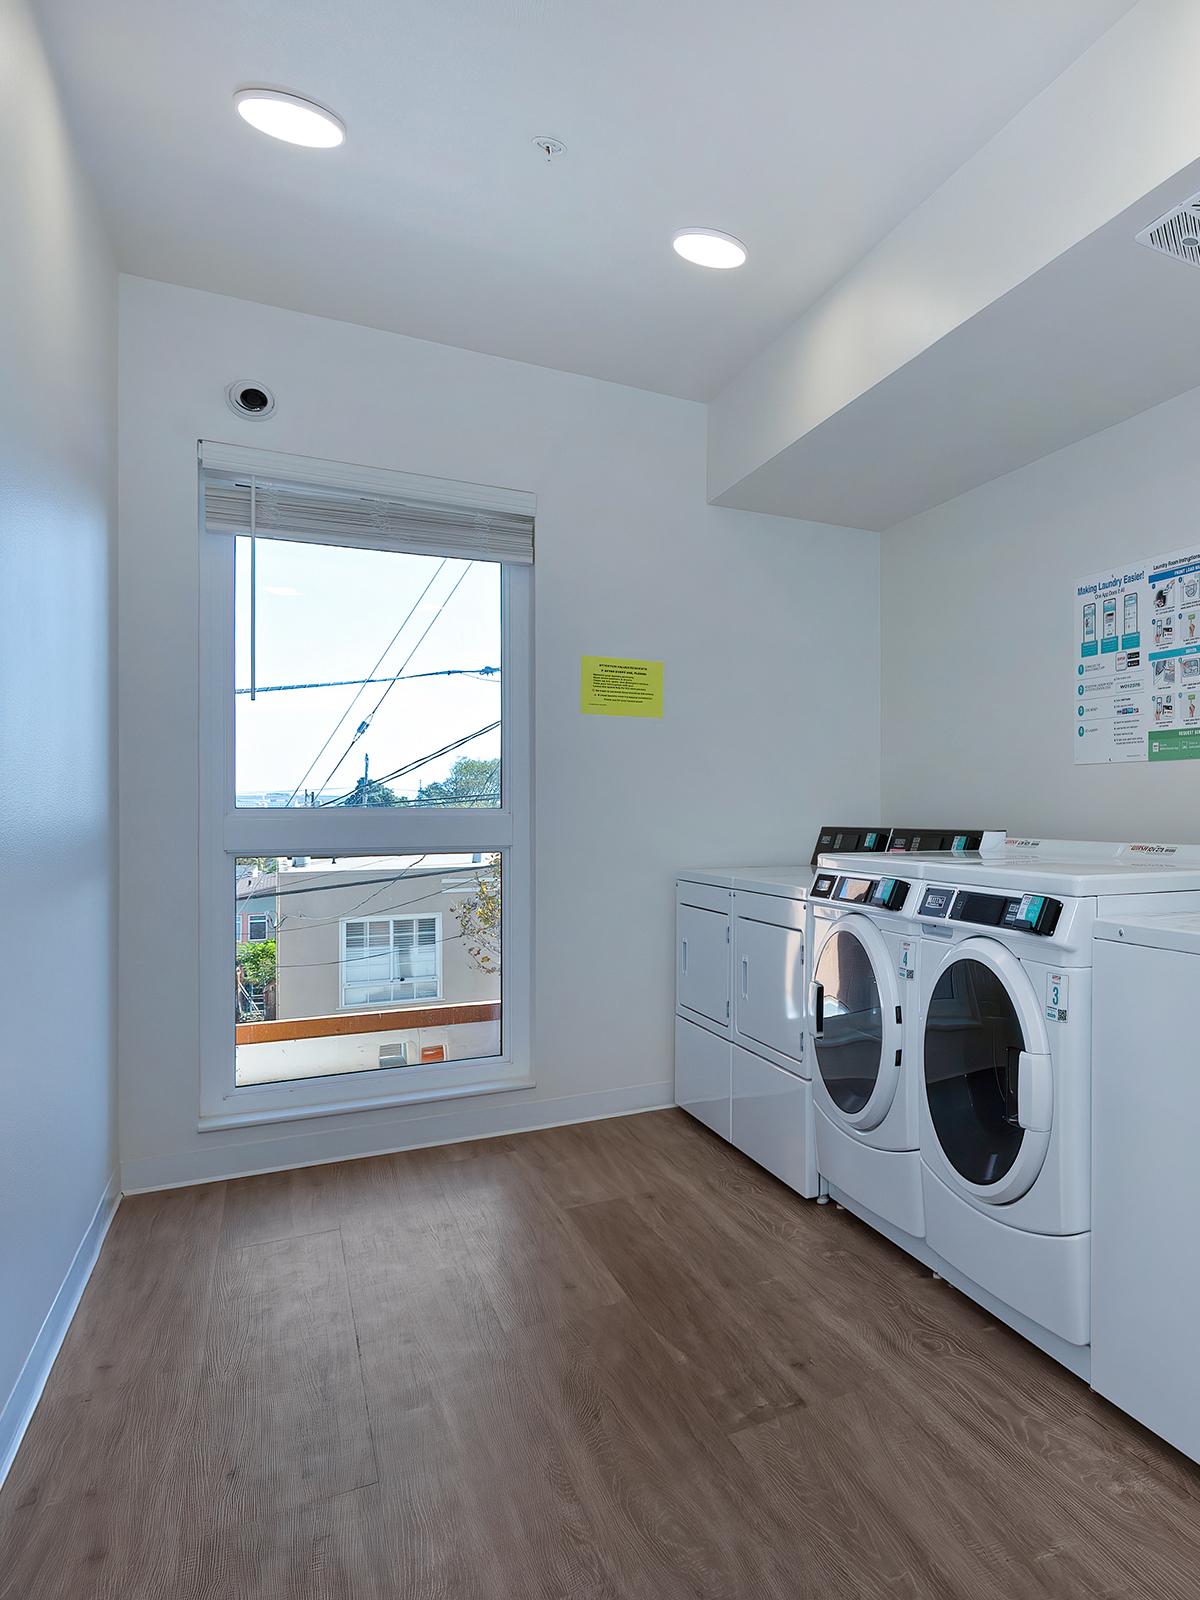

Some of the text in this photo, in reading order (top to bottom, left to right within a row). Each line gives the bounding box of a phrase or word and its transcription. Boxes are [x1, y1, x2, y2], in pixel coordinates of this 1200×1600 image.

[1154, 562, 1167, 570] Laundry
[1179, 554, 1200, 564] Instructions
[1078, 571, 1145, 596] Making Laundry Easier!
[903, 952, 907, 967] 4
[1053, 986, 1058, 1005] 3
